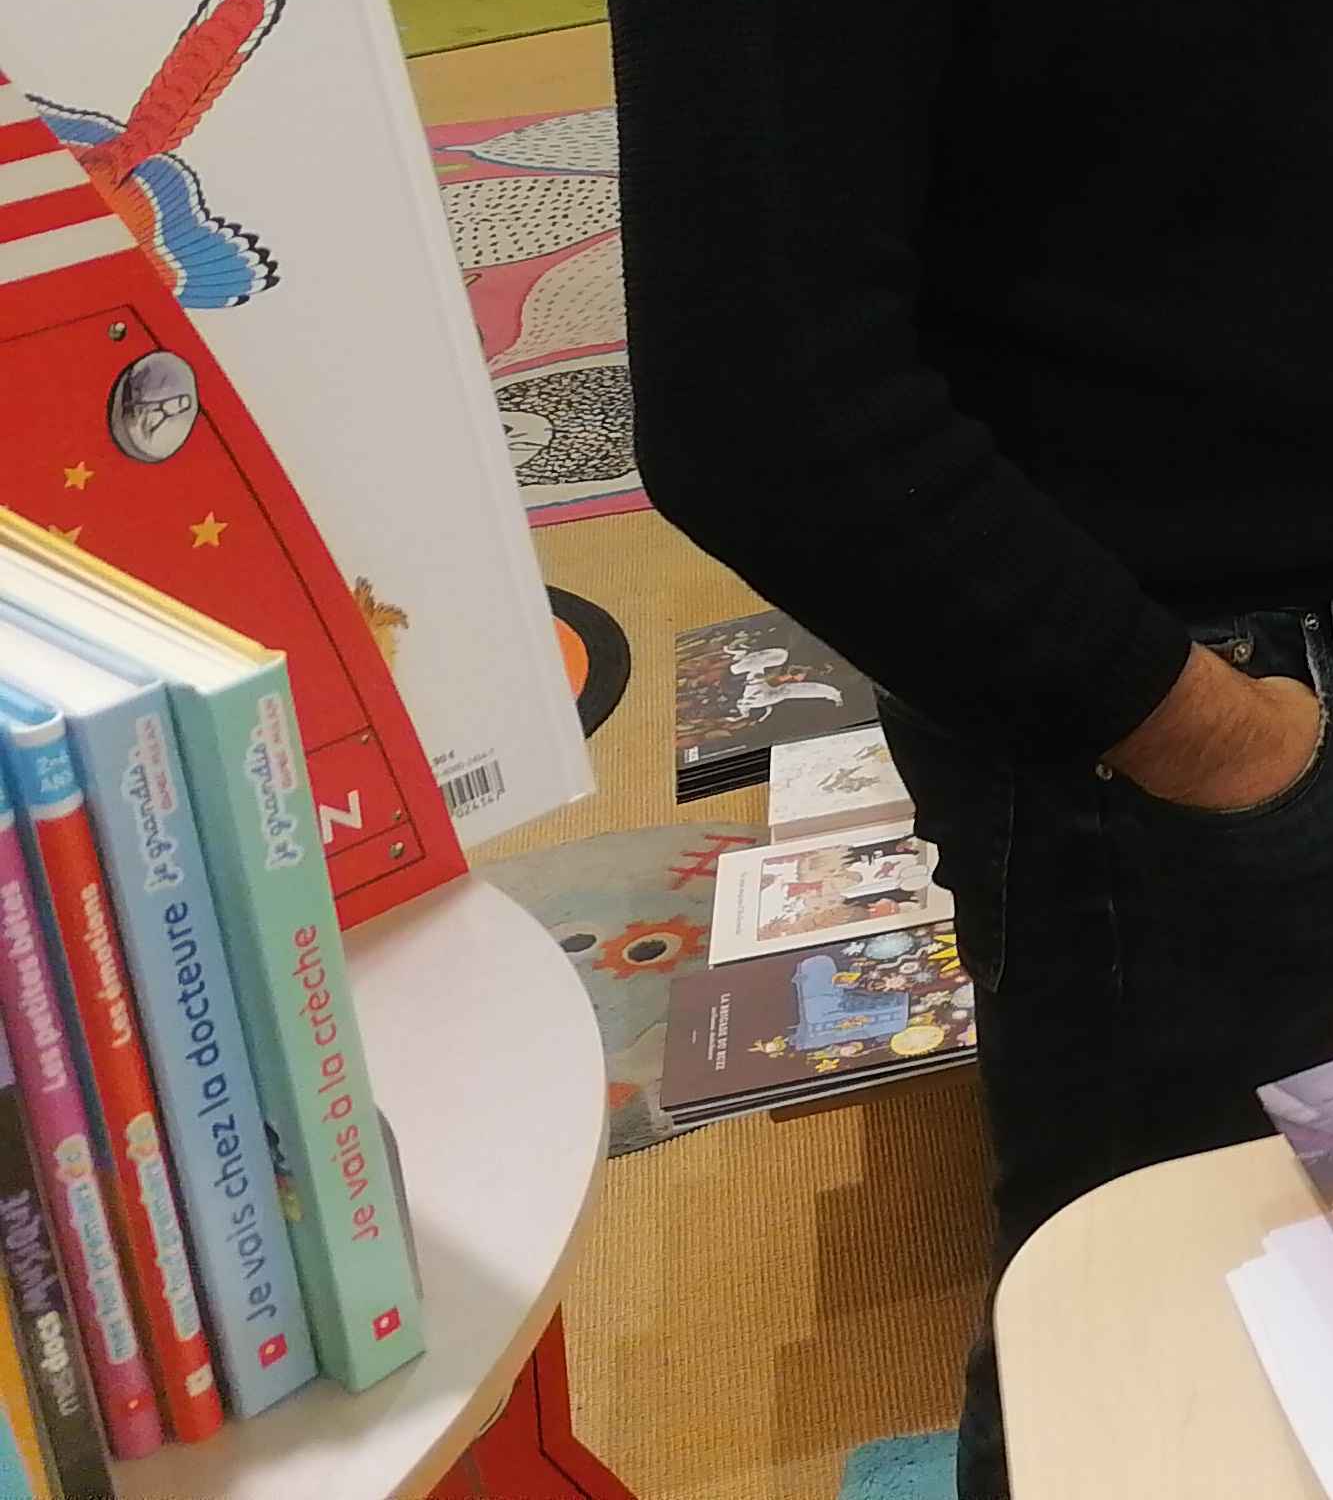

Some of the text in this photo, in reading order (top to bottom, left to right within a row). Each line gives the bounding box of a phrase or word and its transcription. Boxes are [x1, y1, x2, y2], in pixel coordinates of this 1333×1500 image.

[40, 1050, 68, 1092] Les
[80, 883, 133, 1045] Les émotions
[287, 923, 381, 1244] Je vais à la crèche
[159, 900, 282, 1324] Je vais chez la docteure
